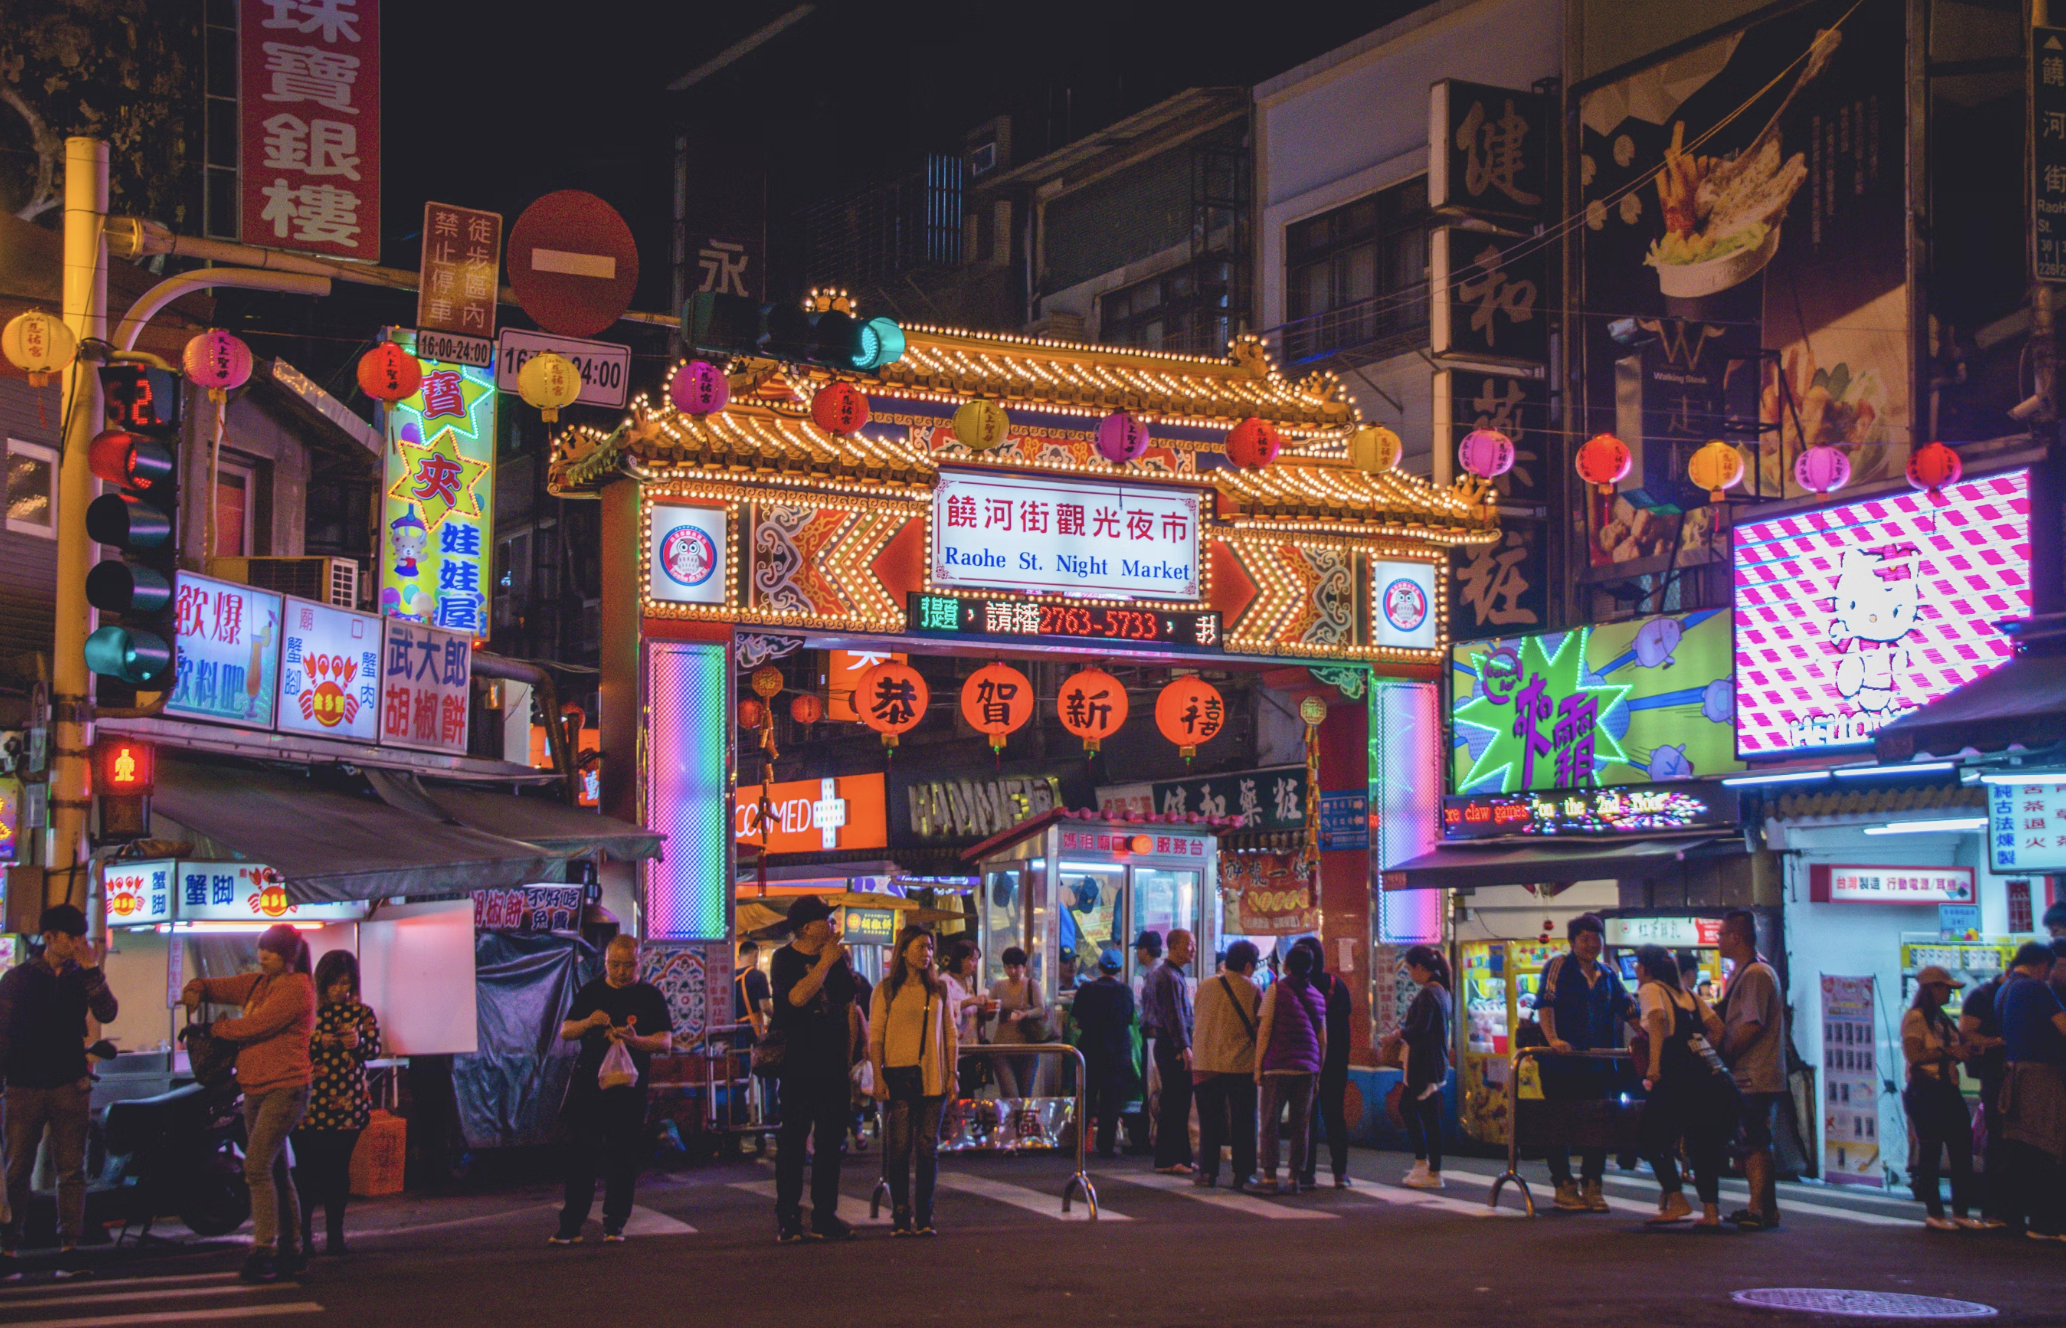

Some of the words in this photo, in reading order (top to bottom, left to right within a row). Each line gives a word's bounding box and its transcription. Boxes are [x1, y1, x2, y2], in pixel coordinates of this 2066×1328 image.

[429, 211, 458, 323] 禁止停車
[462, 217, 492, 329] 徒步區內
[698, 238, 750, 298] 永
[421, 335, 488, 364] 16:00-24:00
[1654, 371, 1684, 384] Walking
[412, 370, 466, 506] 寶夾
[947, 494, 1189, 543] 饒河街觀光夜市
[437, 522, 482, 631] 娃娃屋
[944, 546, 1006, 569] Raohe
[1019, 552, 1043, 570] St.
[1056, 554, 1108, 578] Night
[1122, 560, 1189, 580] Market
[361, 651, 377, 709] 蟹肉
[388, 627, 467, 687] 武大郎
[386, 683, 465, 745] 胡椒餅
[871, 676, 917, 724] 恭
[976, 678, 1018, 726] 賀
[1066, 689, 1112, 730] 新
[1180, 696, 1221, 736] 禧
[735, 798, 812, 838] COMED
[1465, 803, 1491, 822] claw
[1494, 804, 1529, 824] games
[1565, 797, 1586, 816] the
[1596, 794, 1620, 813] 2nd
[1157, 836, 1204, 855] 服務台
[527, 888, 579, 909] 不好吃
[1837, 876, 1880, 891] 台灣製造
